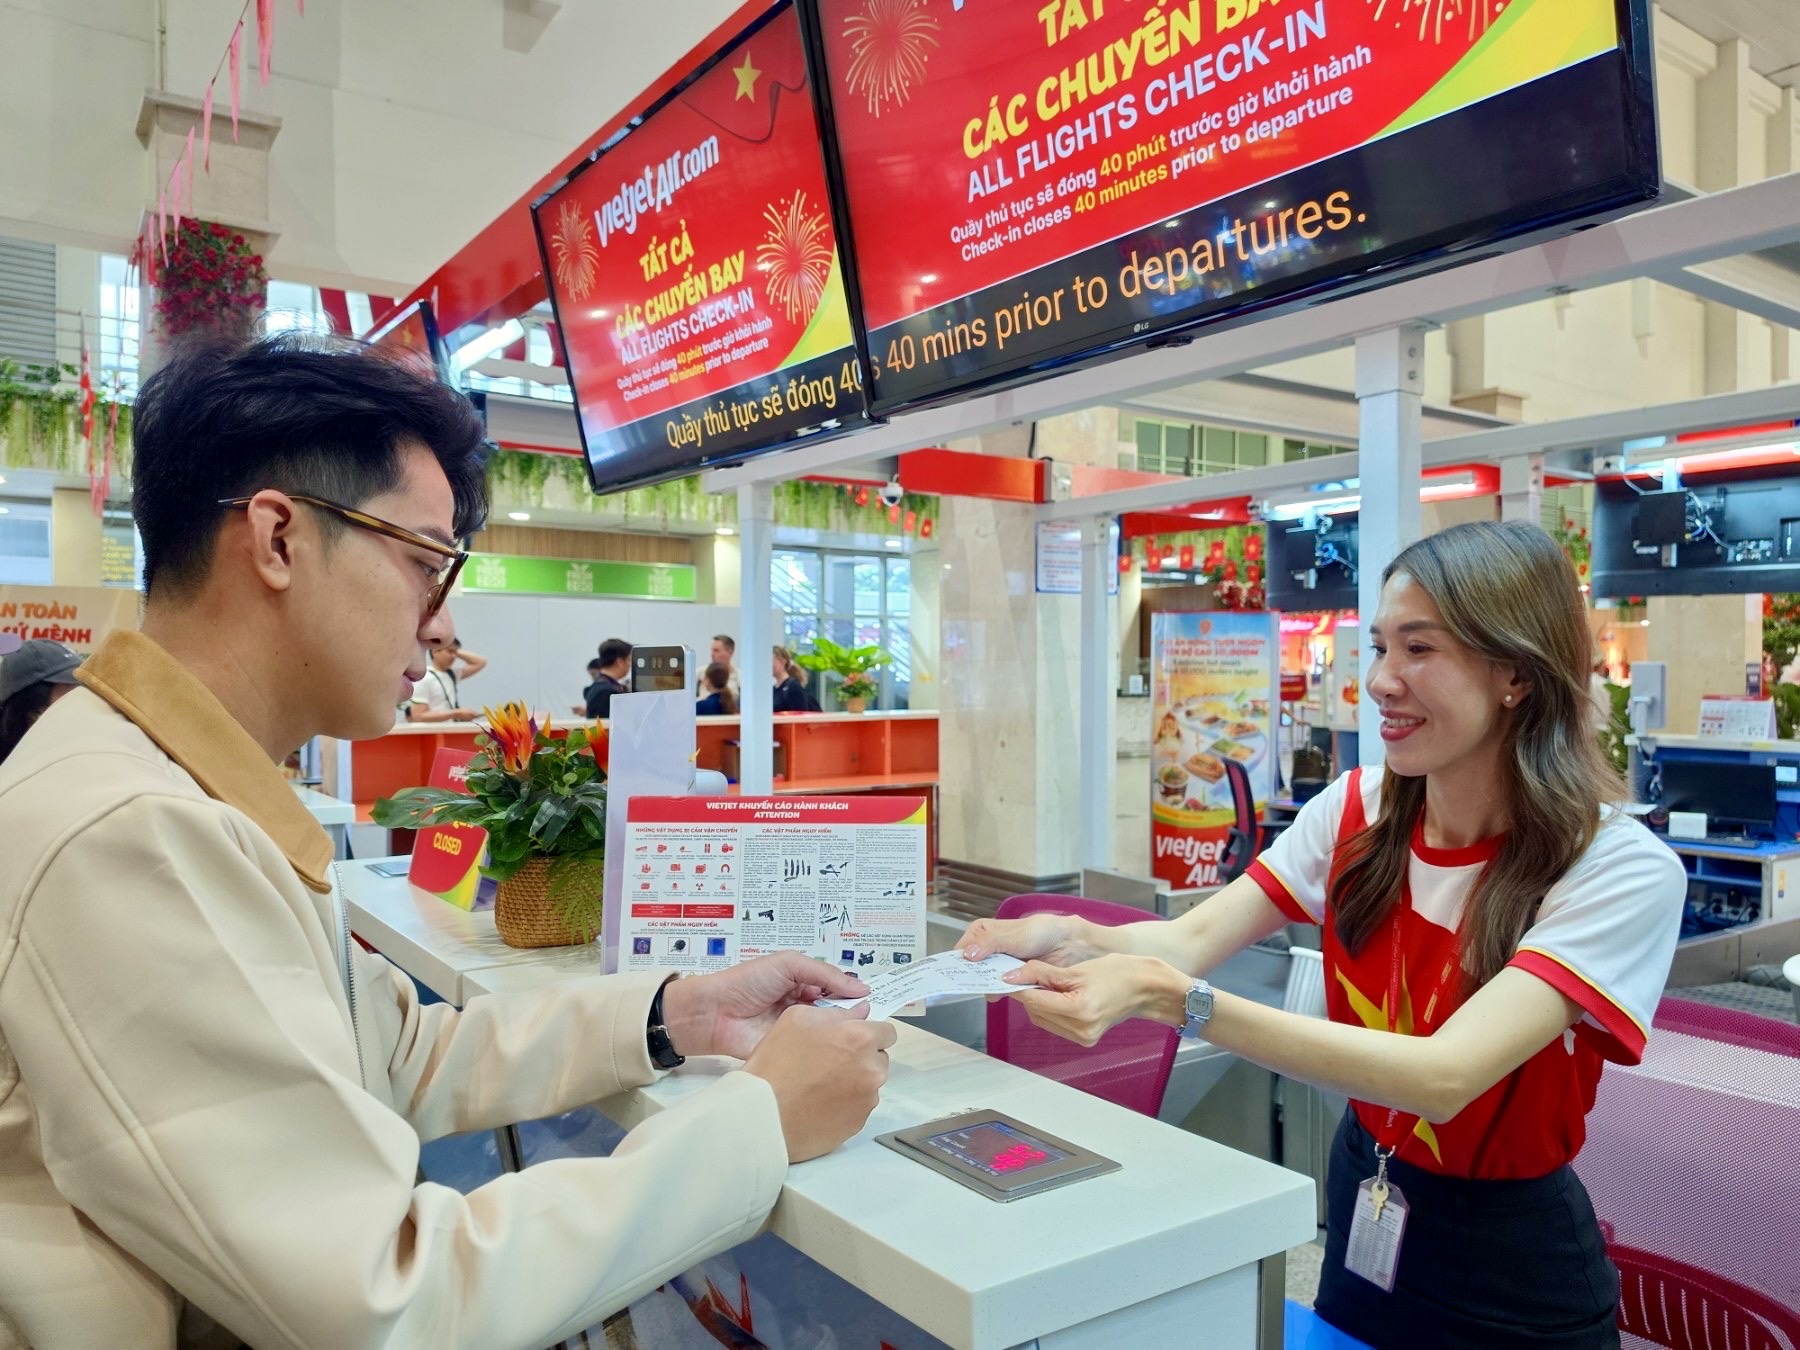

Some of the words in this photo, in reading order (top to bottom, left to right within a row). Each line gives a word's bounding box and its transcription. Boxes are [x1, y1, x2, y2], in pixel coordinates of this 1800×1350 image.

[962, 96, 1028, 160] CÁC
[1036, 0, 1201, 121] CHUYẾN
[968, 163, 1013, 203] ALL
[1017, 96, 1138, 178] FLIGHTS
[1144, 0, 1327, 117] CHECK-IN
[950, 211, 983, 245] Quầy
[985, 198, 1009, 231] thủ
[1010, 190, 1035, 228] tục
[1036, 180, 1055, 207] sẽ
[1057, 163, 1097, 200] đóng
[1100, 154, 1123, 177] 40
[1126, 132, 1167, 174] phút
[1169, 111, 1224, 149] trước
[1227, 90, 1260, 131] giờ
[1262, 69, 1310, 108] khởi
[1313, 44, 1372, 84] hành
[961, 222, 1021, 263] Check-in
[1023, 203, 1072, 239] closes
[1074, 193, 1096, 215] 40
[1099, 162, 1169, 206] minutes
[1170, 141, 1216, 178] prior
[1219, 130, 1242, 155] to
[1245, 85, 1354, 148] departure
[639, 235, 668, 283] TẤT
[670, 218, 695, 266] CẢ
[886, 334, 915, 374] 40
[921, 316, 987, 364] mins
[994, 286, 1065, 350] prior
[1072, 273, 1109, 314] to
[1118, 189, 1367, 299] departures.
[615, 303, 644, 340] CÁC
[644, 263, 708, 325] CHUYẾN
[708, 249, 745, 295] BAY
[621, 335, 642, 366] ALL
[640, 318, 690, 357] FLIGHTS
[688, 286, 756, 331] CHECK-IN
[623, 382, 650, 402] Check-in
[649, 377, 670, 393] closes
[669, 372, 679, 385] 40
[678, 362, 705, 382] minutes
[704, 355, 723, 374] prior
[722, 351, 732, 364] to
[731, 336, 770, 361] departure
[677, 352, 687, 365] 40
[751, 315, 773, 335] hành
[666, 412, 703, 449] Quầy
[703, 399, 730, 436] thủ
[730, 398, 760, 432] tục
[761, 385, 784, 416] sẽ
[786, 373, 836, 409] đóng
[0, 602, 17, 619] N
[22, 600, 78, 621] TOÀN
[706, 802, 738, 810] VIETJET
[739, 800, 773, 810] KHUYẾN
[774, 801, 793, 810] CÁO
[794, 801, 818, 810] HÀNH
[819, 801, 848, 810] KHÁCH
[754, 811, 800, 819] ATTENTION
[433, 832, 462, 856] CLOSED
